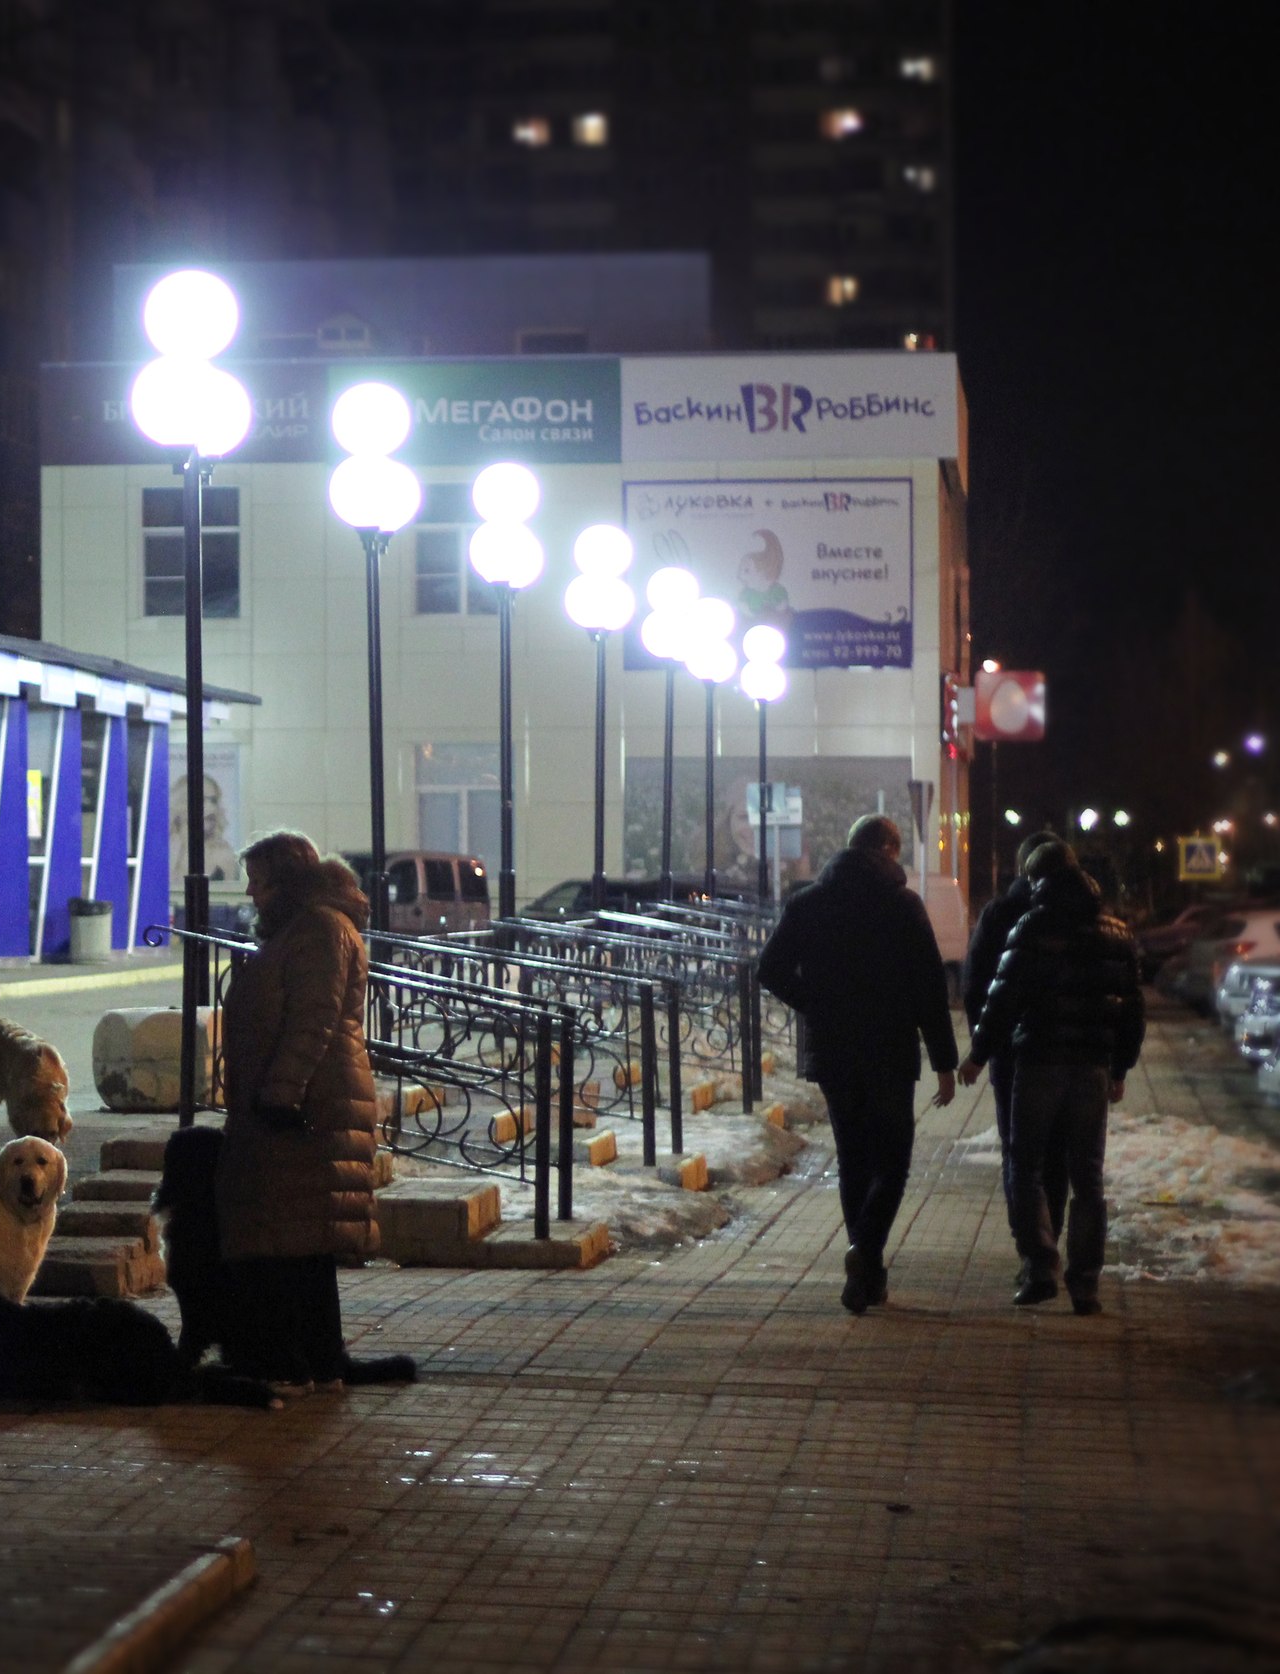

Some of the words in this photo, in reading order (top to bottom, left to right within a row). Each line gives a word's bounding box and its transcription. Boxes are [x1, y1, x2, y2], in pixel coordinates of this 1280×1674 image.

[634, 397, 742, 426] Баскин
[480, 424, 535, 441] Салон
[540, 427, 593, 441] связи
[816, 542, 882, 559] Вместе
